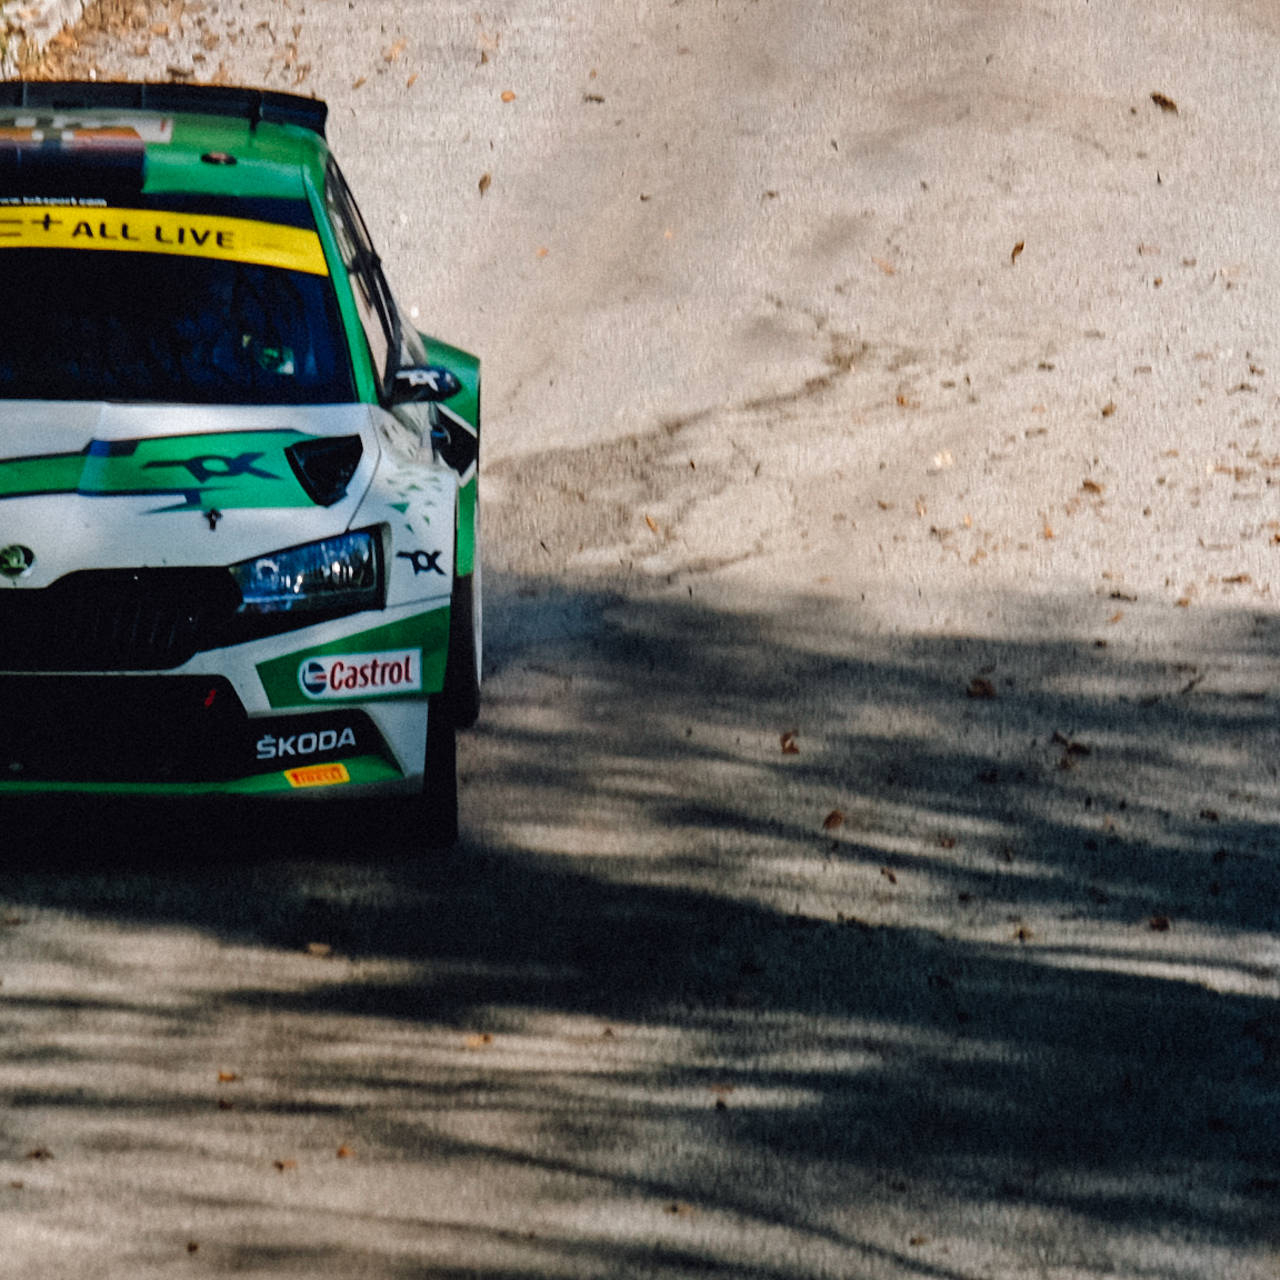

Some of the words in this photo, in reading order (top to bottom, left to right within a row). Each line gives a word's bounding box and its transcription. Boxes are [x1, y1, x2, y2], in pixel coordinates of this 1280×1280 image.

[72, 221, 139, 241] ALL
[154, 225, 235, 249] LIVE
[330, 655, 413, 691] Castrol
[256, 727, 356, 759] ŠKODA
